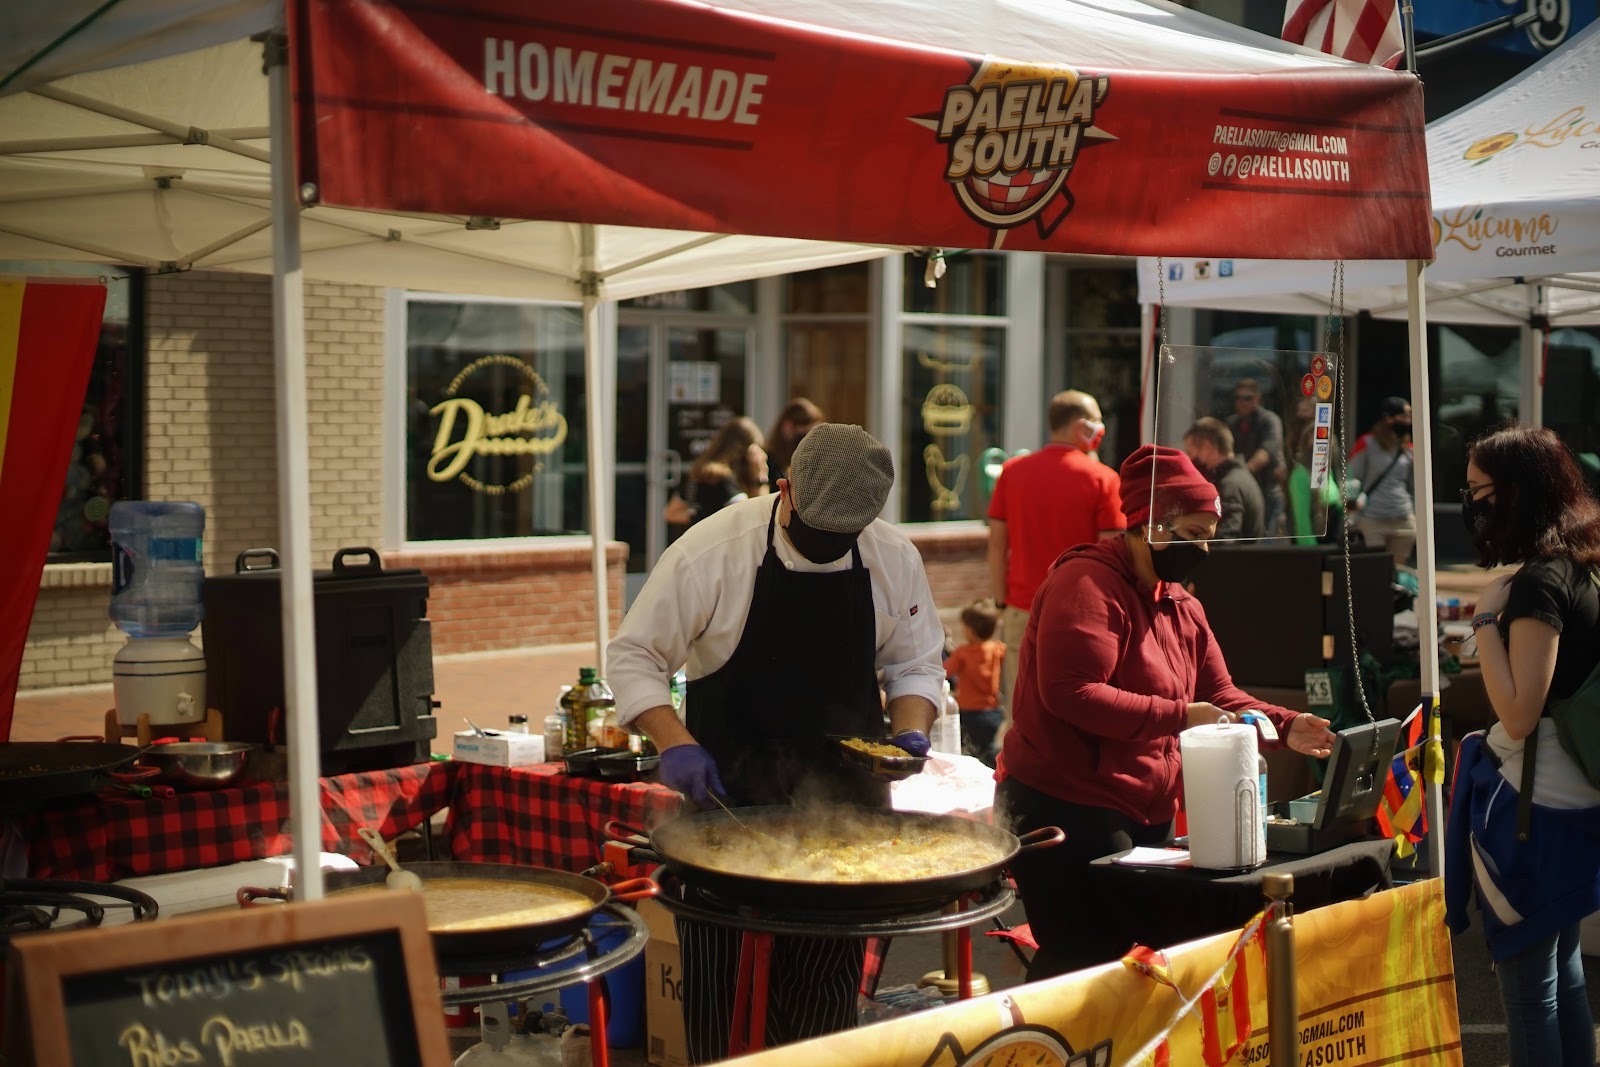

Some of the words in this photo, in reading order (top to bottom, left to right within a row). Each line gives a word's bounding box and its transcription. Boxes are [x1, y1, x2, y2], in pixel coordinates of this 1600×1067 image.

[484, 36, 768, 125] HOMEMADE
[945, 122, 1081, 178] SOUTH
[1213, 125, 1348, 155] PAELLASOUTH@GMAIL.COM
[1237, 154, 1350, 182] @PAELLASOUTH
[1495, 243, 1557, 257] Gourmet
